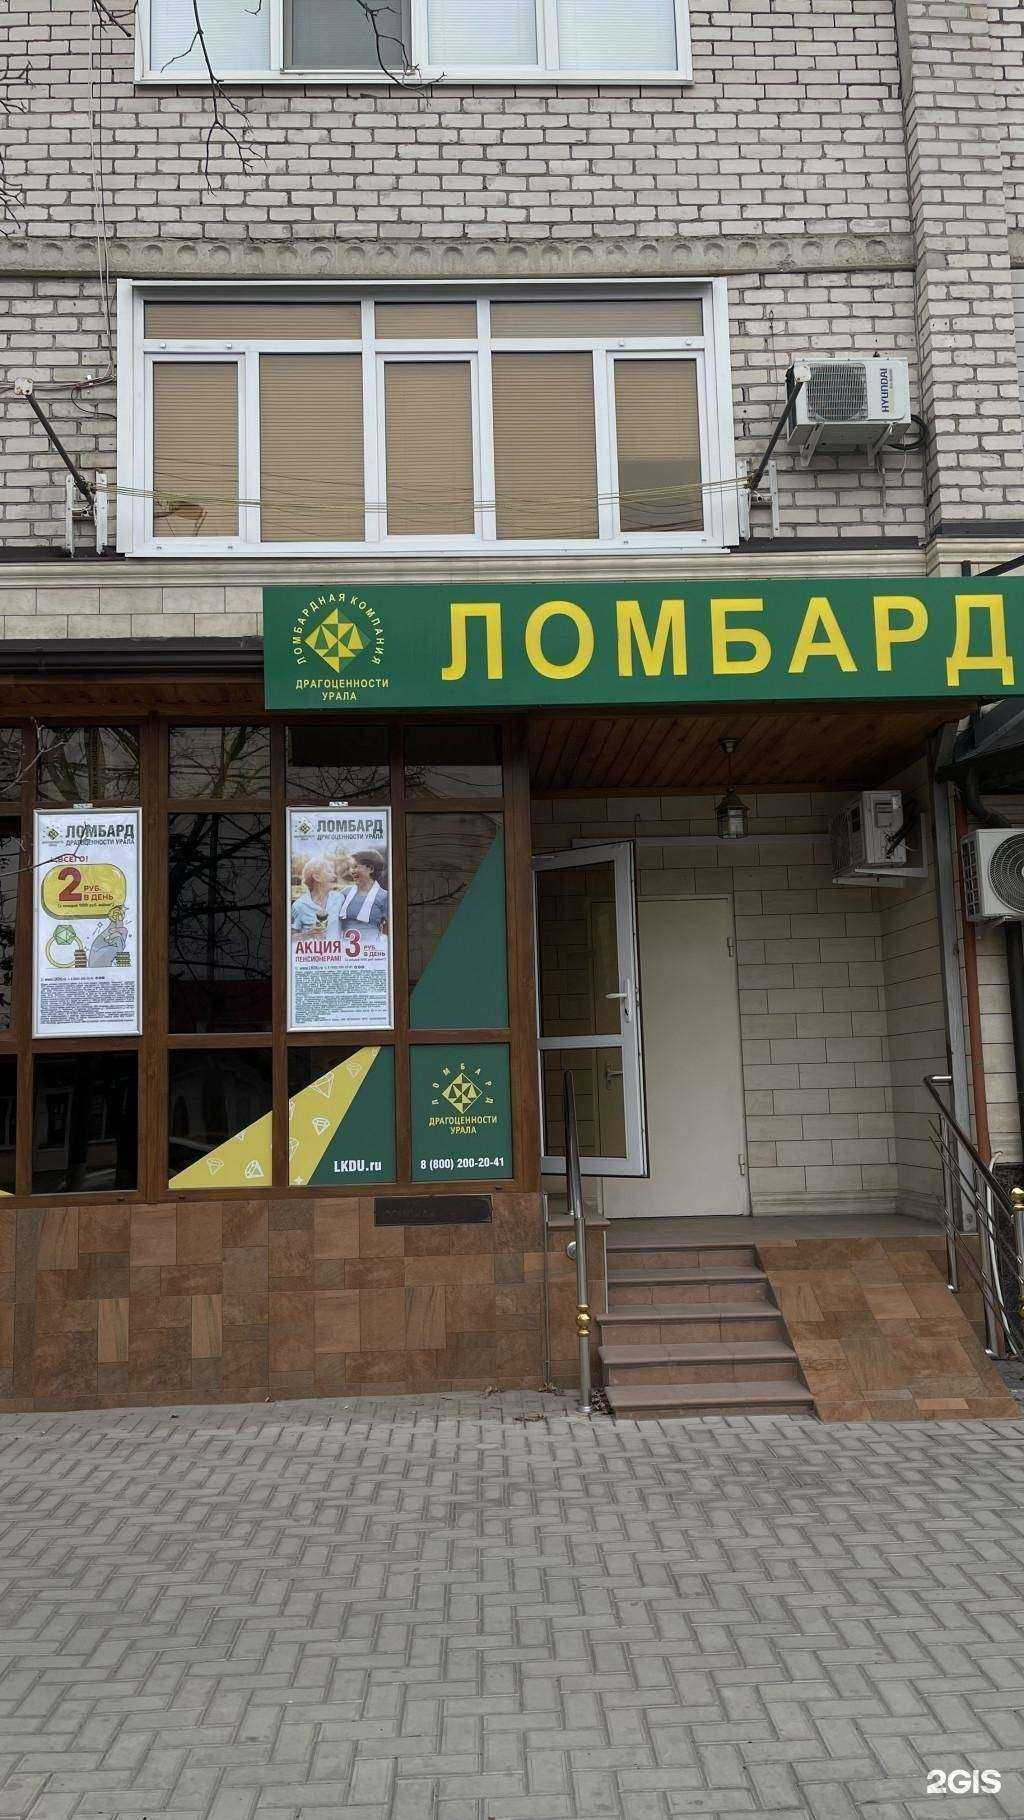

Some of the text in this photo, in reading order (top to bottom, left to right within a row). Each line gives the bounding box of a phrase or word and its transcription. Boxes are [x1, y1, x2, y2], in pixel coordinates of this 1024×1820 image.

[880, 368, 889, 413] HYUNDAI
[292, 593, 385, 665] ЛОМБАРДНАЯ КОМПАНИЯ
[441, 594, 1016, 687] ЛОМБАРД
[295, 679, 389, 690] ДРАГОЦЕННОСТИ
[321, 691, 357, 701] УРАЛА
[65, 825, 134, 839] ЛОМБАРД
[317, 820, 383, 834] ЛОМБАРД
[58, 866, 82, 902] 2
[91, 894, 114, 902] ДЕНЬ
[296, 941, 341, 955] АКЦИЯ
[345, 929, 360, 957] 3
[431, 1062, 494, 1106] ЛОМБАРД
[428, 1115, 498, 1127] ДРАГОЦЕННОСТИ
[450, 1125, 477, 1135] УРАЛА
[333, 1159, 382, 1173] LKDU.ru
[420, 1157, 504, 1171] 8 (800) 200-20-41
